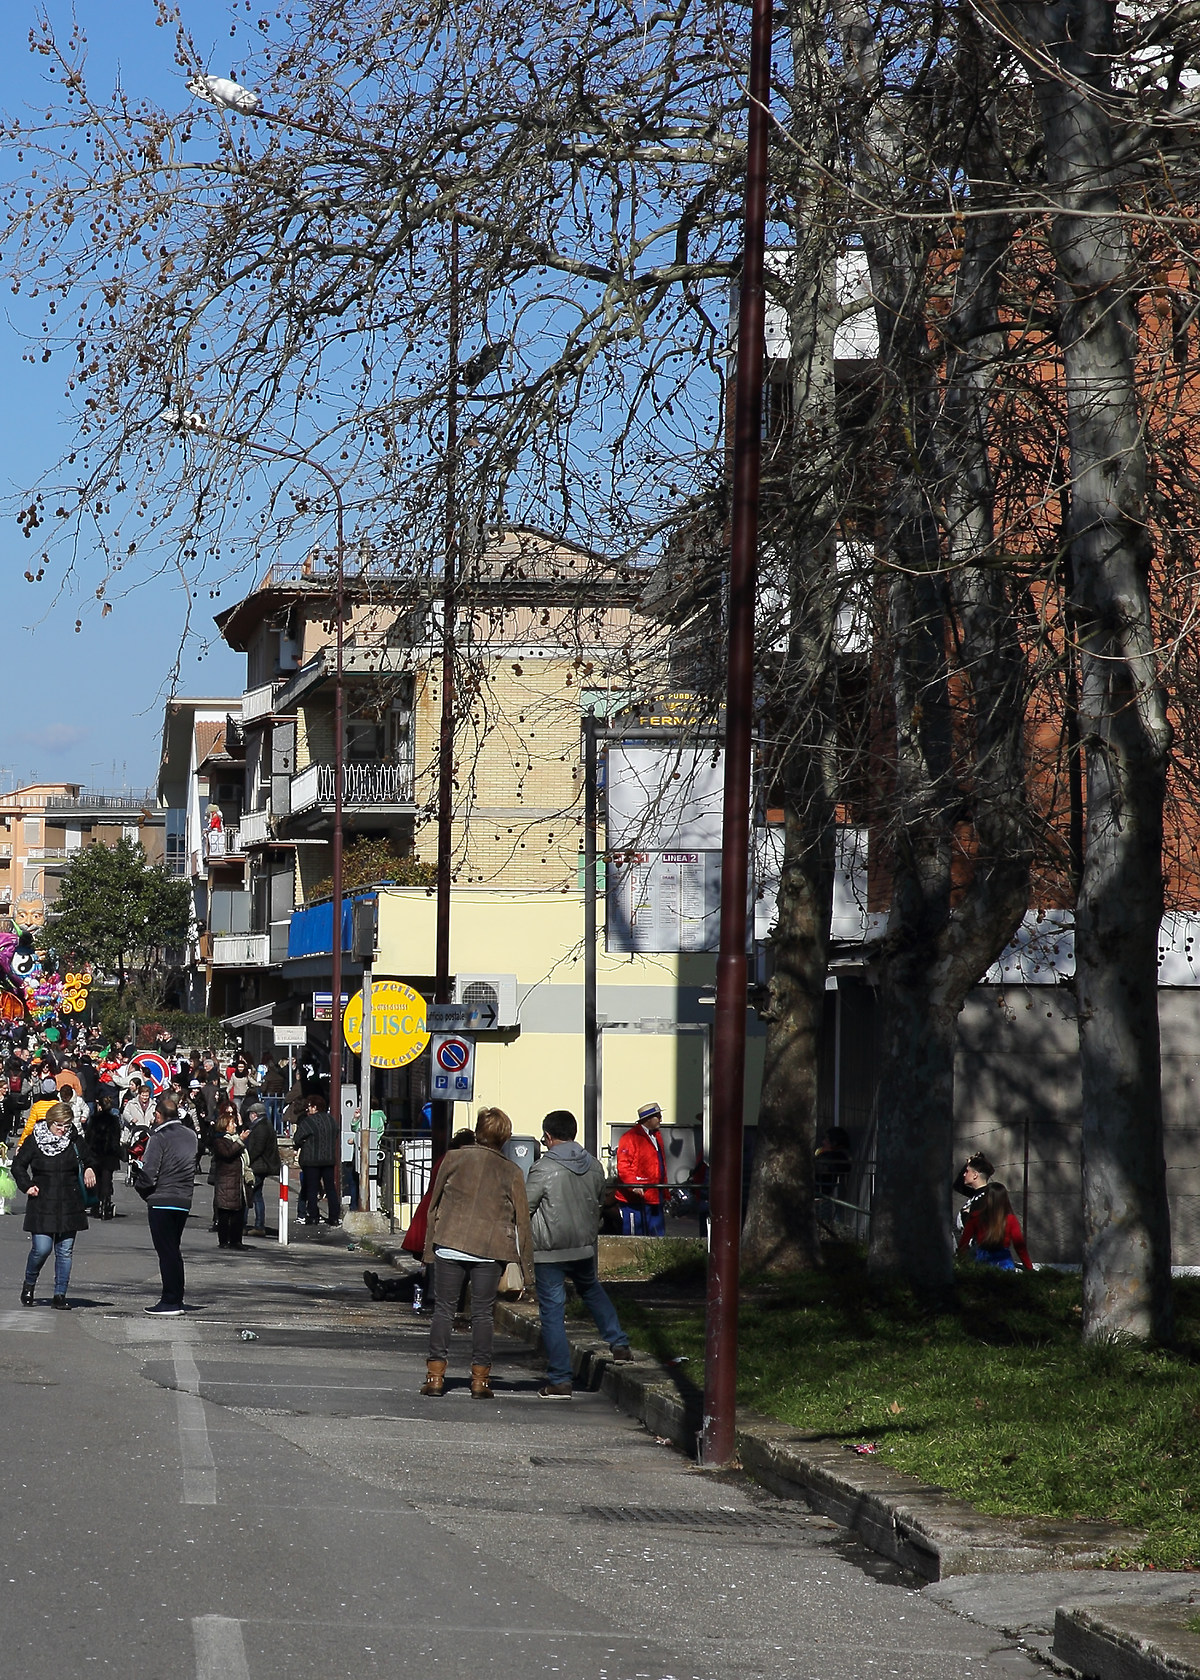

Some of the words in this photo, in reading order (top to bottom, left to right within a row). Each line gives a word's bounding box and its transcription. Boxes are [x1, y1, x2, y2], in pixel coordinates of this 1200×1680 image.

[640, 716, 719, 726] FERMAA
[662, 854, 688, 862] LINEA
[690, 854, 697, 863] 2
[359, 983, 417, 1002] zzeria
[445, 1011, 465, 1022] postale
[348, 1014, 427, 1036] FLISCA
[438, 1078, 447, 1088] P
